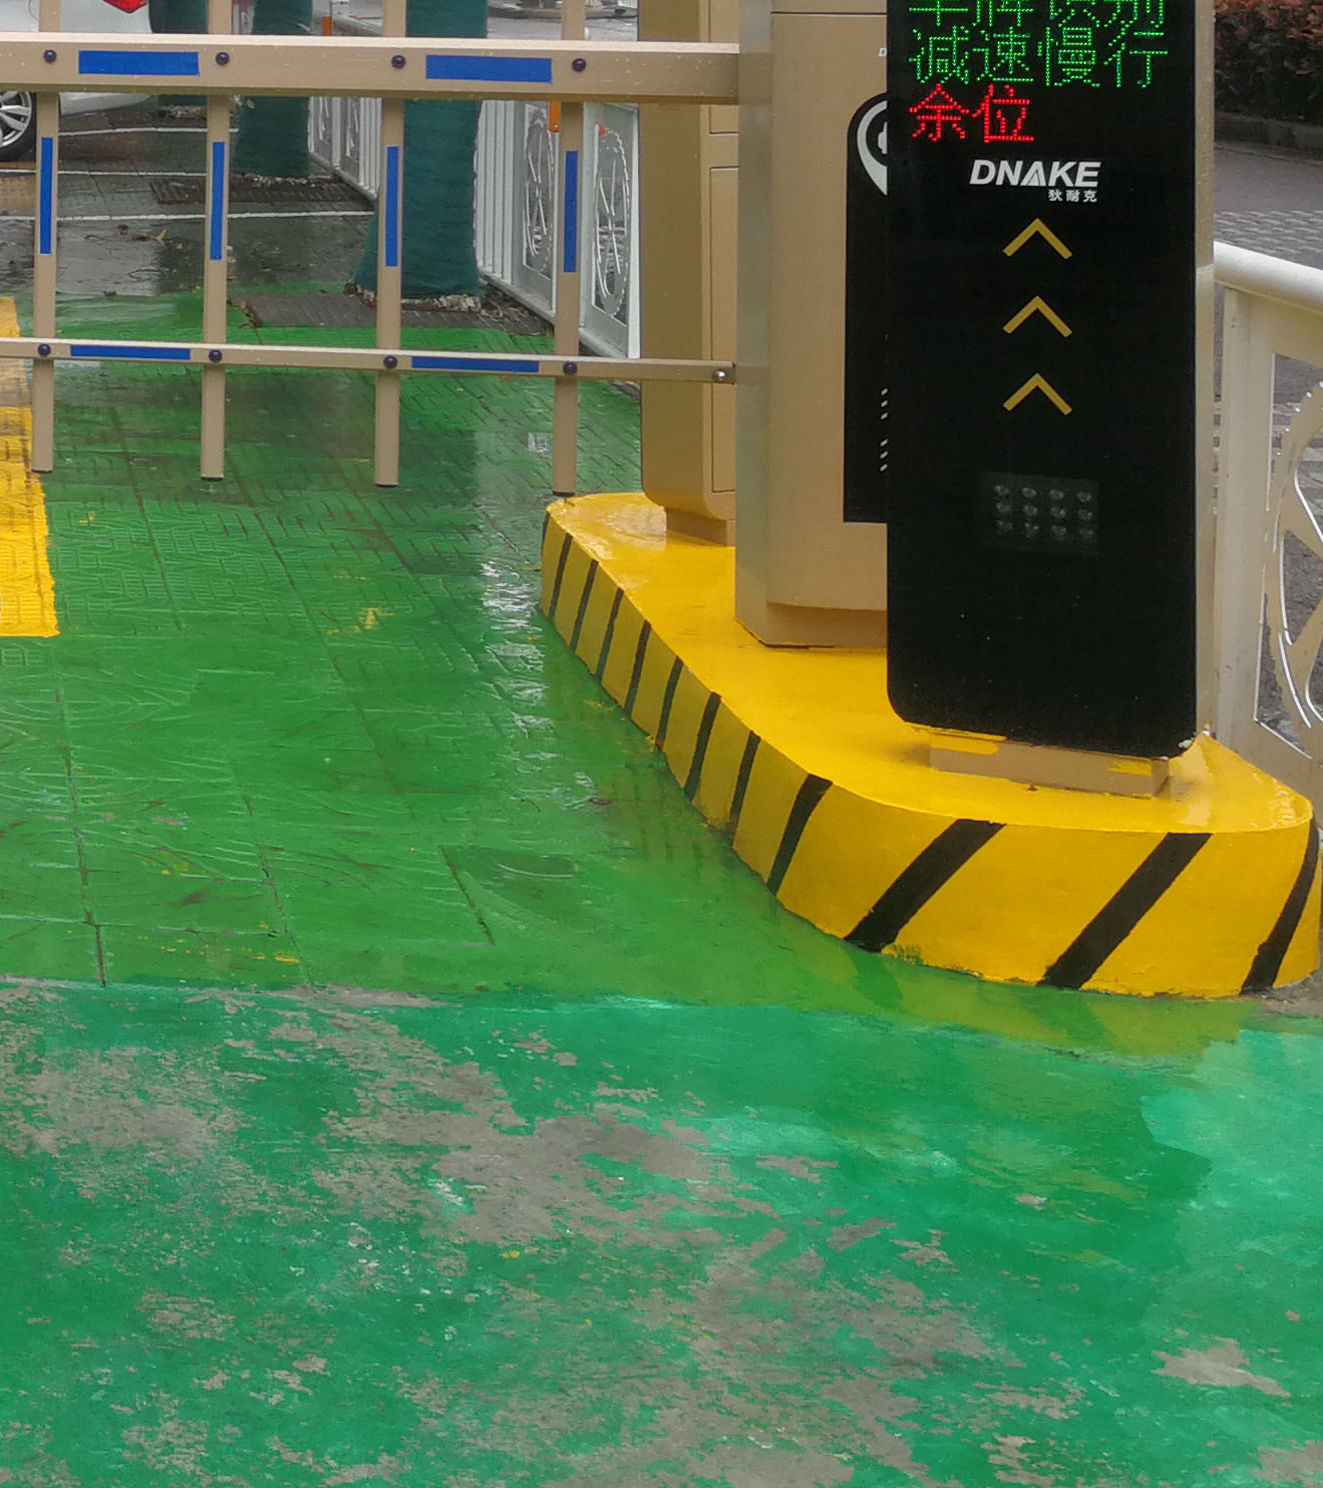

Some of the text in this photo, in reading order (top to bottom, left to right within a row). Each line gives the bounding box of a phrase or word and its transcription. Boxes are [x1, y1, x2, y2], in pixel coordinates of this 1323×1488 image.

[908, 26, 1169, 88] 减速慢行
[908, 83, 1035, 144] 余位
[969, 159, 1102, 188] DNAKE
[1047, 189, 1099, 203] 狄耐克
